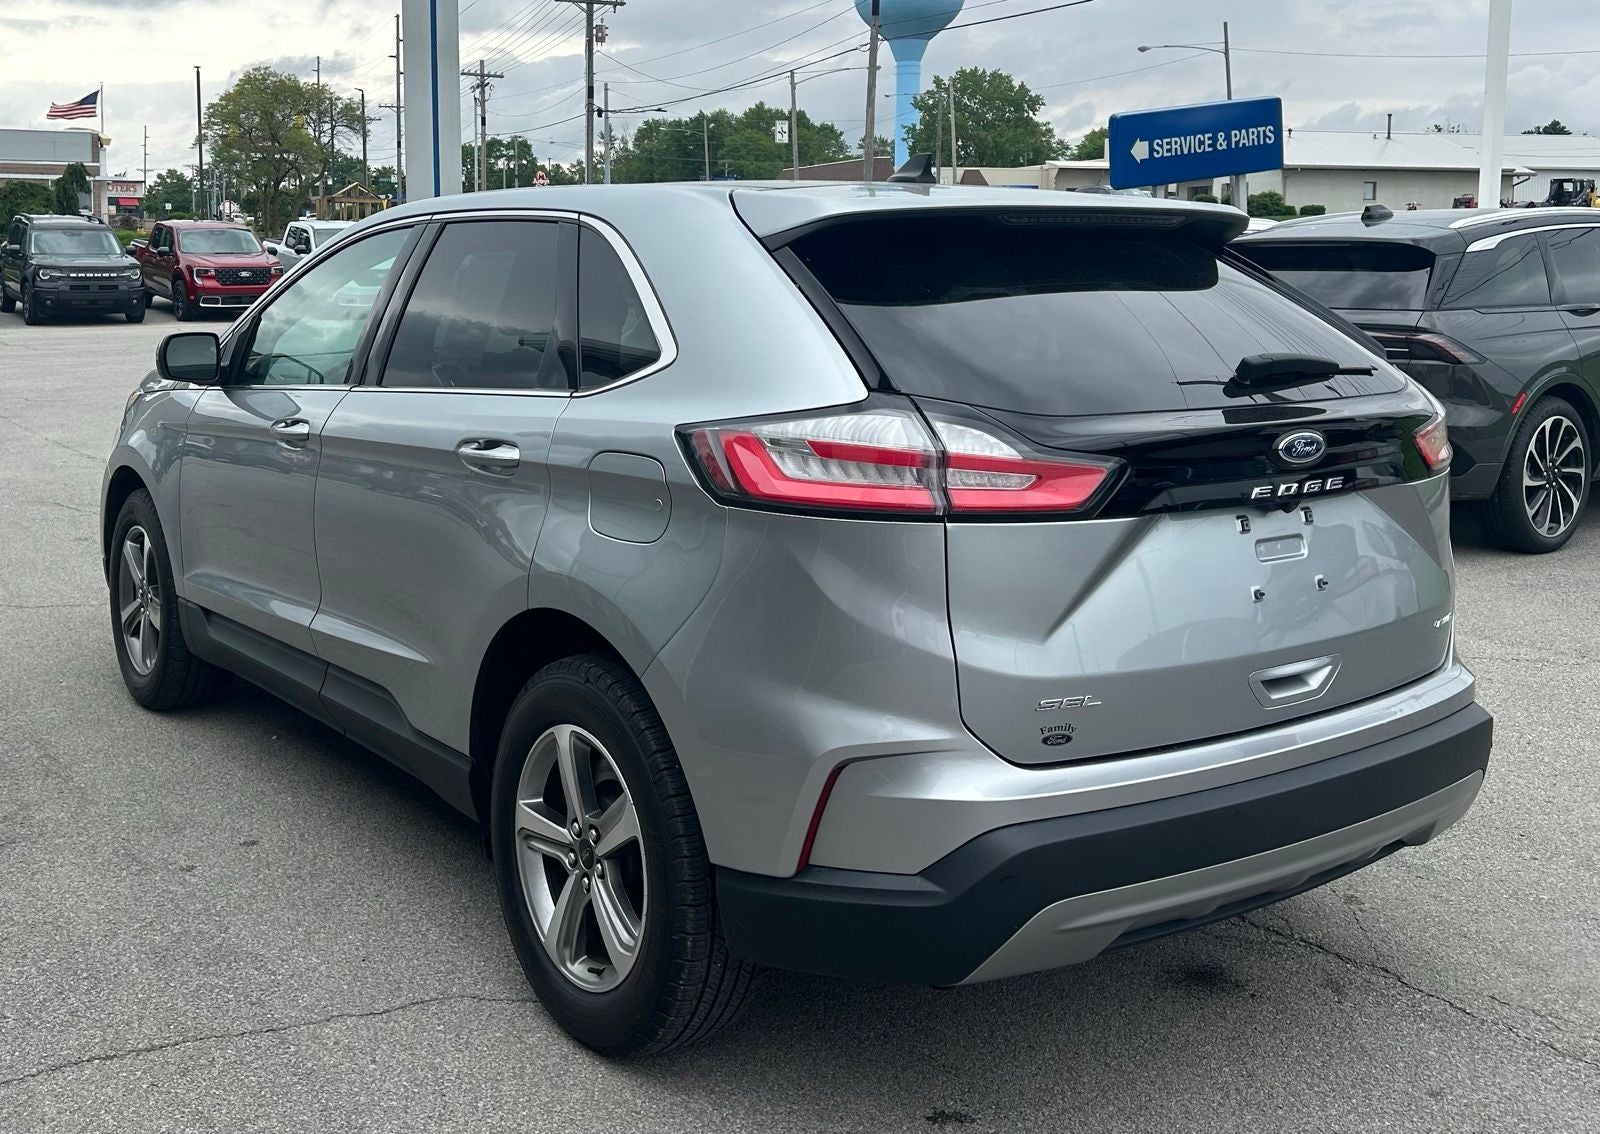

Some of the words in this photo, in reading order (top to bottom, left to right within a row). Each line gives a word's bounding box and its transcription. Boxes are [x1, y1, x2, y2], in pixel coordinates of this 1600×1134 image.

[1153, 133, 1213, 159] SERVICE
[1216, 131, 1228, 150] &
[1231, 125, 1275, 148] PARTS
[1291, 439, 1317, 457] Ford
[1251, 476, 1345, 500] EDGE
[1035, 695, 1102, 711] SEL
[1040, 723, 1077, 735] Family
[1047, 735, 1068, 745] Ford
